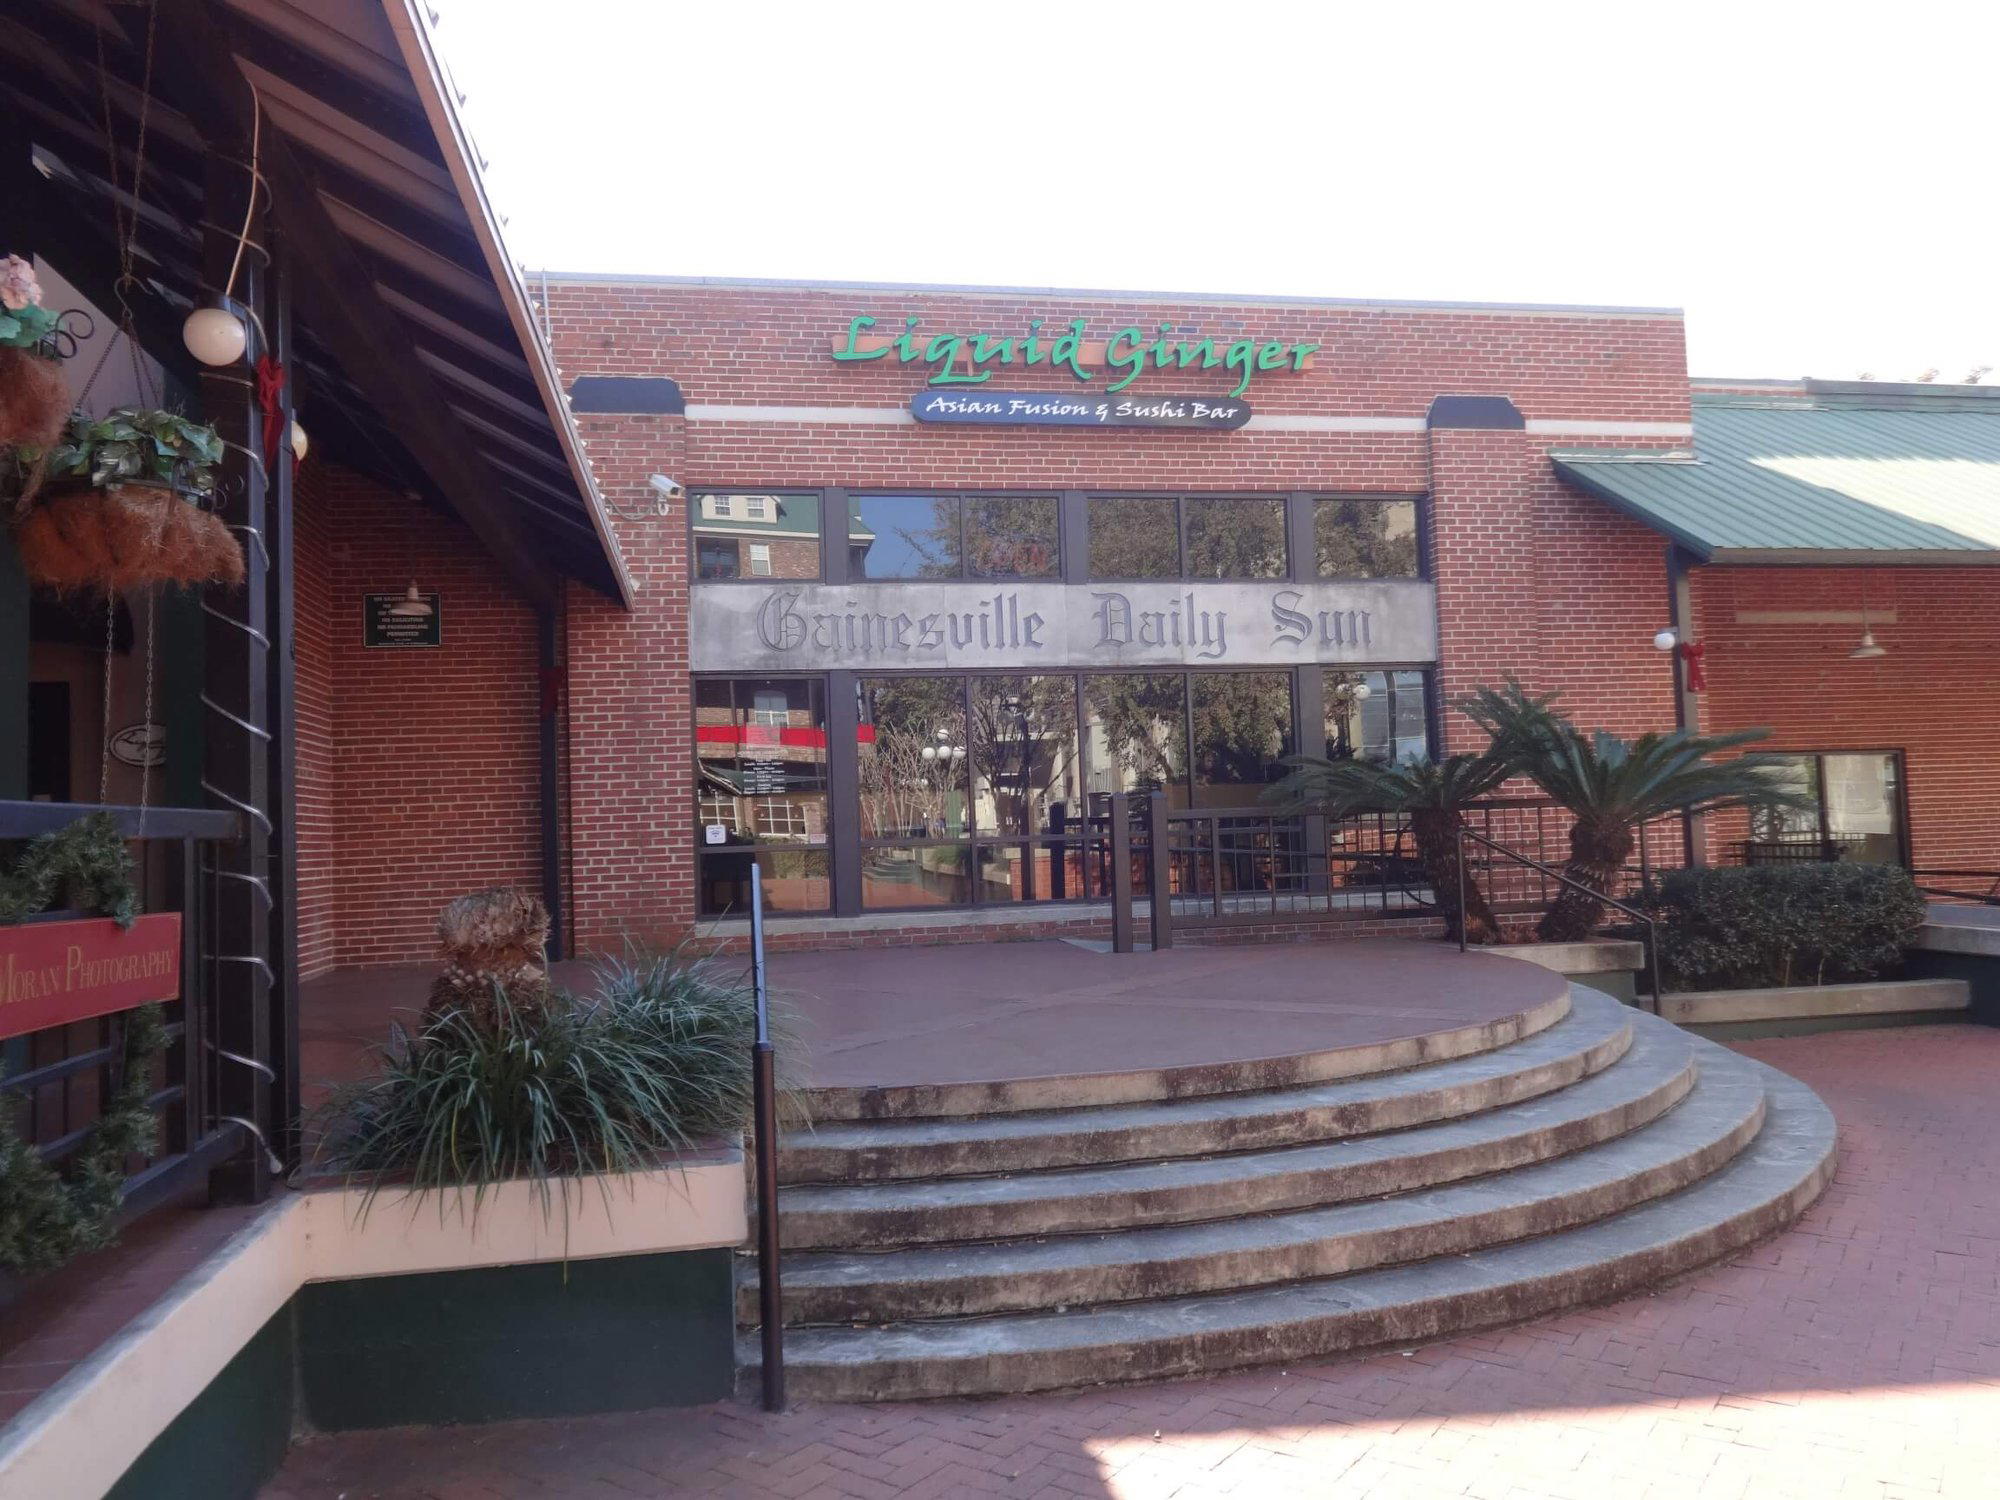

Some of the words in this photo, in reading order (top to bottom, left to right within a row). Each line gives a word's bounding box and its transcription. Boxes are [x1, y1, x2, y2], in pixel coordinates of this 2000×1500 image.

[831, 315, 1092, 386] Liquid
[1105, 321, 1321, 398] Ginger
[926, 396, 1002, 414] Asian
[1008, 399, 1089, 417] Fusion
[1115, 403, 1186, 419] Sushi
[1191, 403, 1239, 420] Bar
[757, 591, 1046, 652] Gainesville
[1091, 591, 1227, 660] Daily
[1270, 590, 1373, 649] Sun
[66, 945, 174, 992] PHOTOGRAPHY
